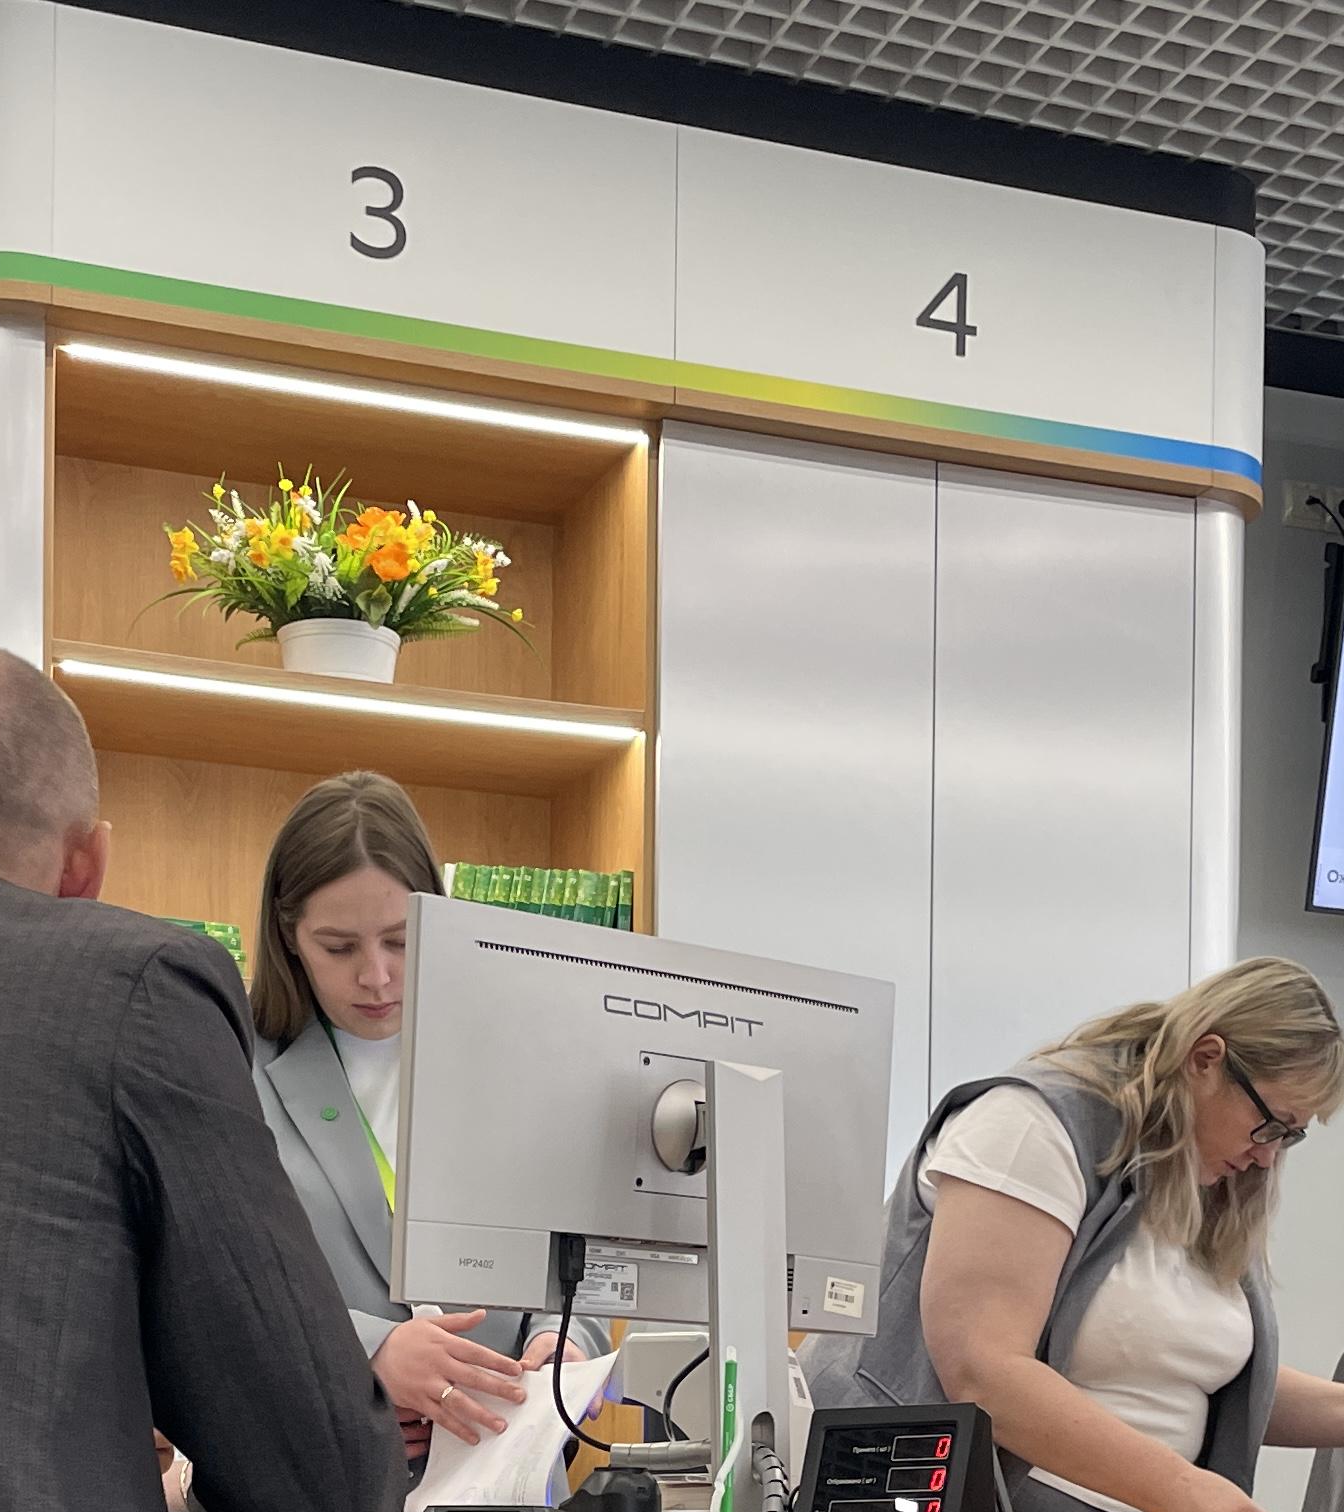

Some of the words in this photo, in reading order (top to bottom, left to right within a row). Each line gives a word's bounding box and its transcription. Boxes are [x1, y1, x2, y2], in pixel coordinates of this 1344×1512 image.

[349, 165, 408, 260] 3
[915, 272, 978, 357] 4
[603, 994, 764, 1037] COMPIT
